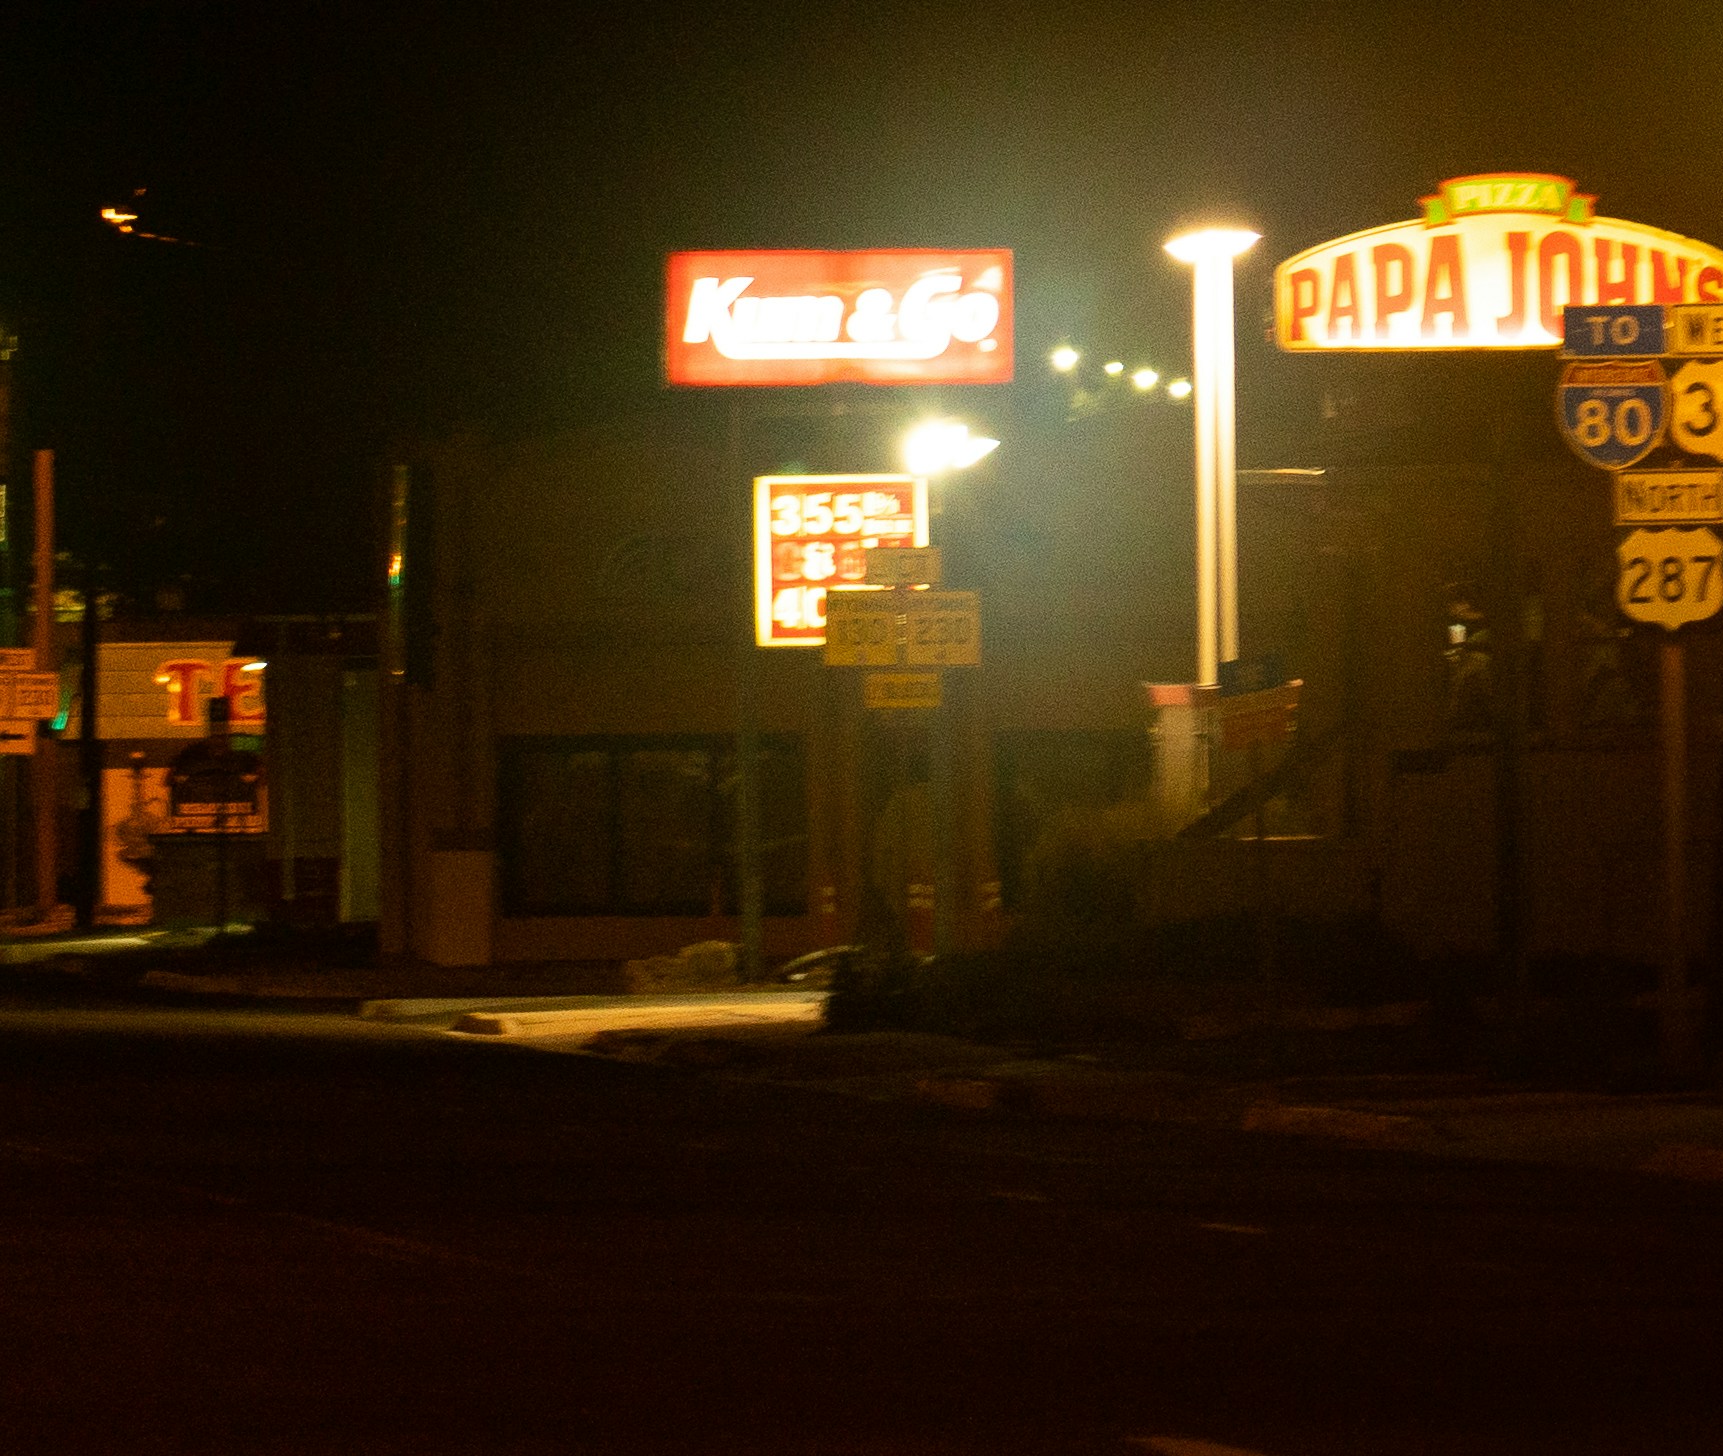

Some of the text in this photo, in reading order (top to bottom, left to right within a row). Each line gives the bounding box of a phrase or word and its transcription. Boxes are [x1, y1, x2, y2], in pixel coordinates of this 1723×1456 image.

[1452, 182, 1563, 211] PIZZA
[1291, 234, 1471, 341] PAPA
[1586, 315, 1641, 346] TO
[1574, 397, 1654, 448] 80
[1624, 478, 1720, 513] NORTH
[1629, 554, 1719, 605] 287
